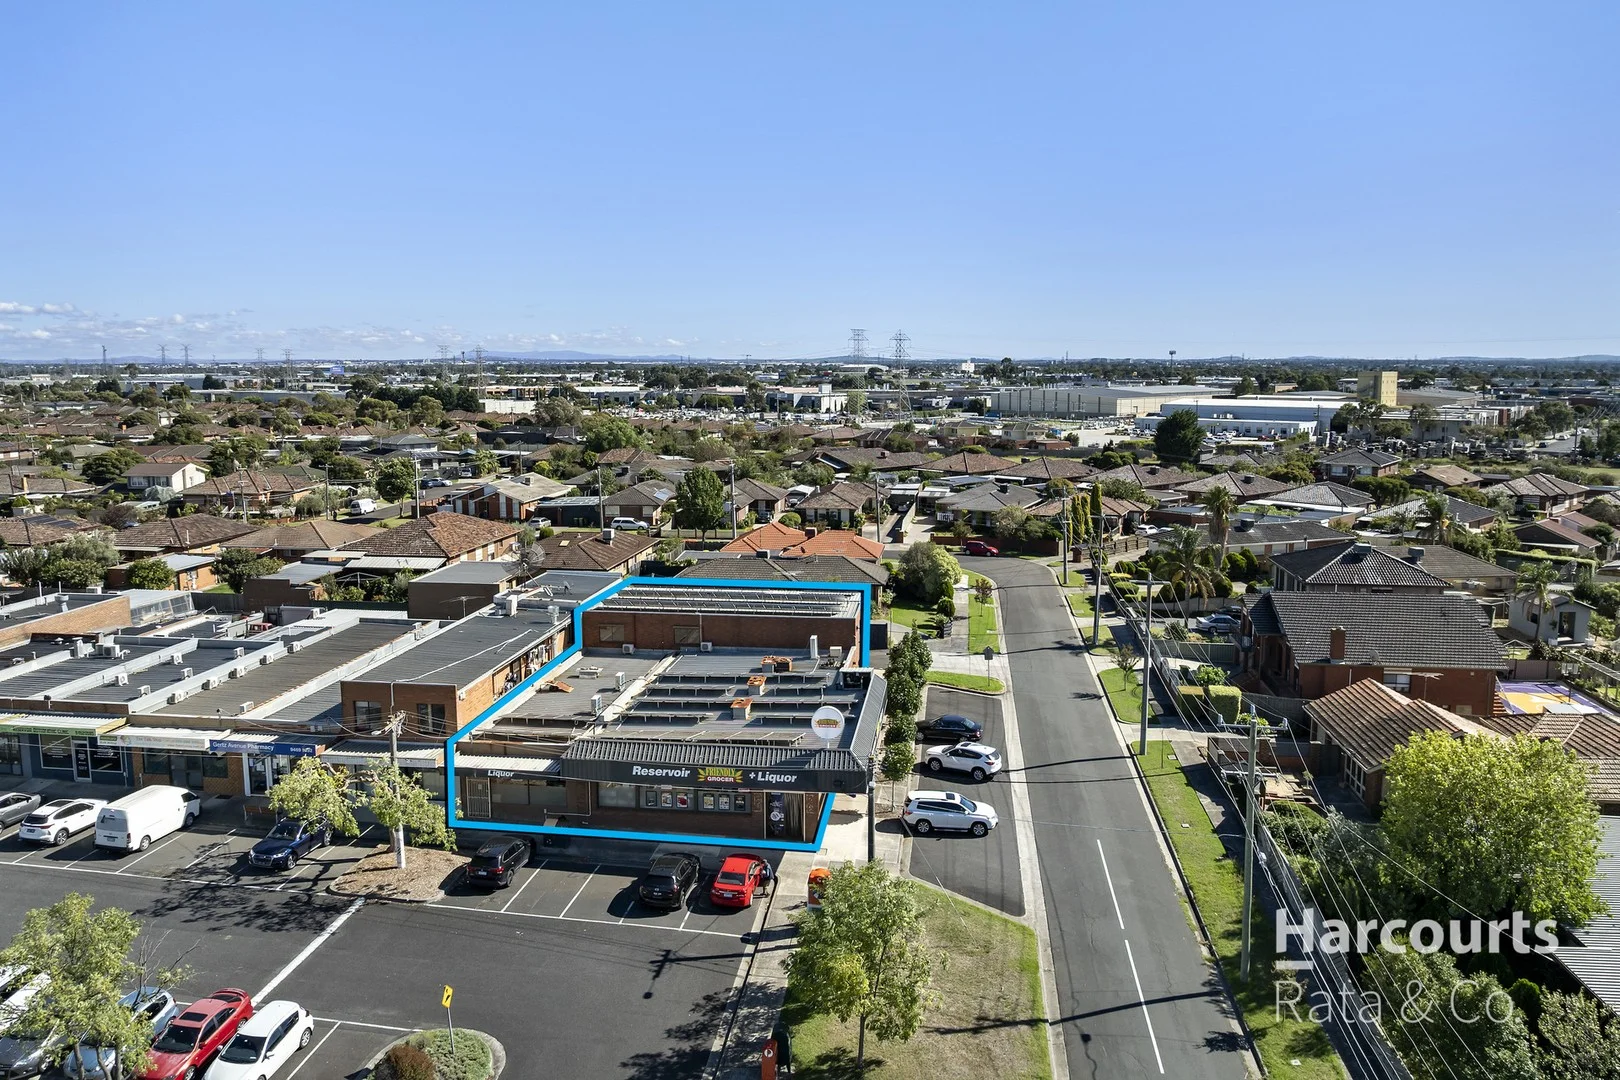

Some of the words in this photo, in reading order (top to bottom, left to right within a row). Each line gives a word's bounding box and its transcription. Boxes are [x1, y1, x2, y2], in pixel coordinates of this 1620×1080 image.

[247, 743, 275, 751] Pharmacy
[487, 769, 515, 778] Liquor
[632, 765, 691, 778] Reservoir
[705, 767, 736, 777] FRIENDLY
[757, 771, 798, 784] Liquor
